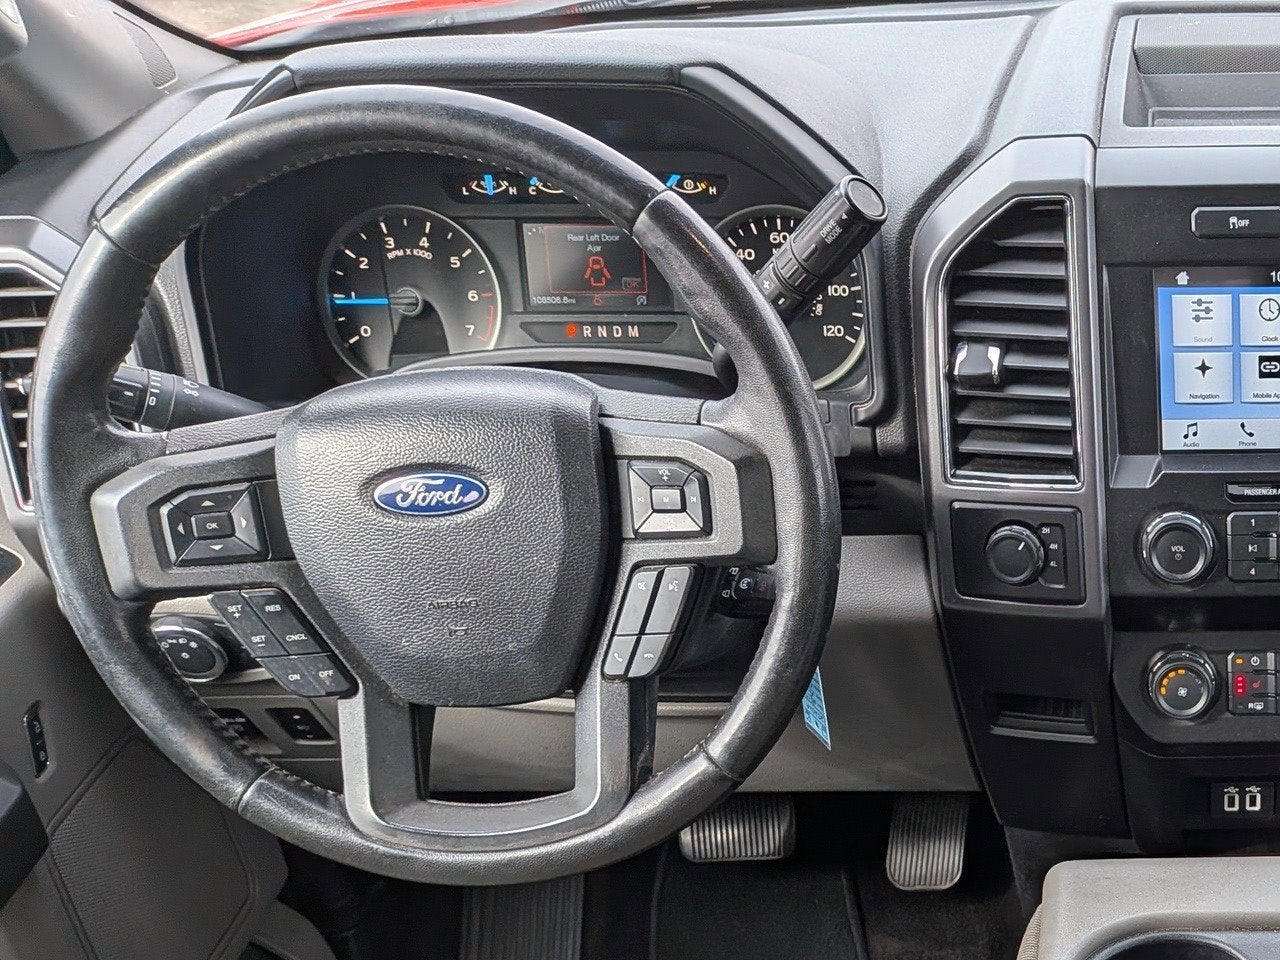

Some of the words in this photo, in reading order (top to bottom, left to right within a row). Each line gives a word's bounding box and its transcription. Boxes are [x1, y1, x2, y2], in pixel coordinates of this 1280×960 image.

[462, 187, 469, 195] L
[508, 187, 517, 195] H
[528, 187, 537, 195] C
[709, 186, 716, 195] H
[820, 219, 837, 238] DRIVE
[568, 234, 584, 242] Rear
[769, 232, 790, 243] 60
[825, 225, 843, 245] MODE
[385, 237, 395, 249] 3
[419, 237, 430, 248] 4
[386, 250, 404, 260] RPM
[412, 249, 433, 260] 1000
[735, 249, 755, 260] 40
[359, 258, 369, 269] 2
[450, 257, 461, 268] 5
[468, 290, 479, 301] 6
[828, 285, 849, 296] 100
[360, 326, 371, 337] 0
[465, 325, 475, 336] 7
[583, 326, 592, 337] R
[598, 326, 607, 337] N
[613, 326, 622, 337] D
[628, 326, 639, 337] M
[823, 325, 844, 337] 120
[396, 479, 463, 507] Ford
[1244, 488, 1278, 496] PASSENGER
[206, 522, 219, 530] OK
[1249, 567, 1256, 575] 4
[227, 604, 242, 612] SET
[264, 604, 281, 612] RES
[251, 635, 266, 643] SET
[286, 634, 307, 642] CNCL
[319, 670, 334, 678] OFF
